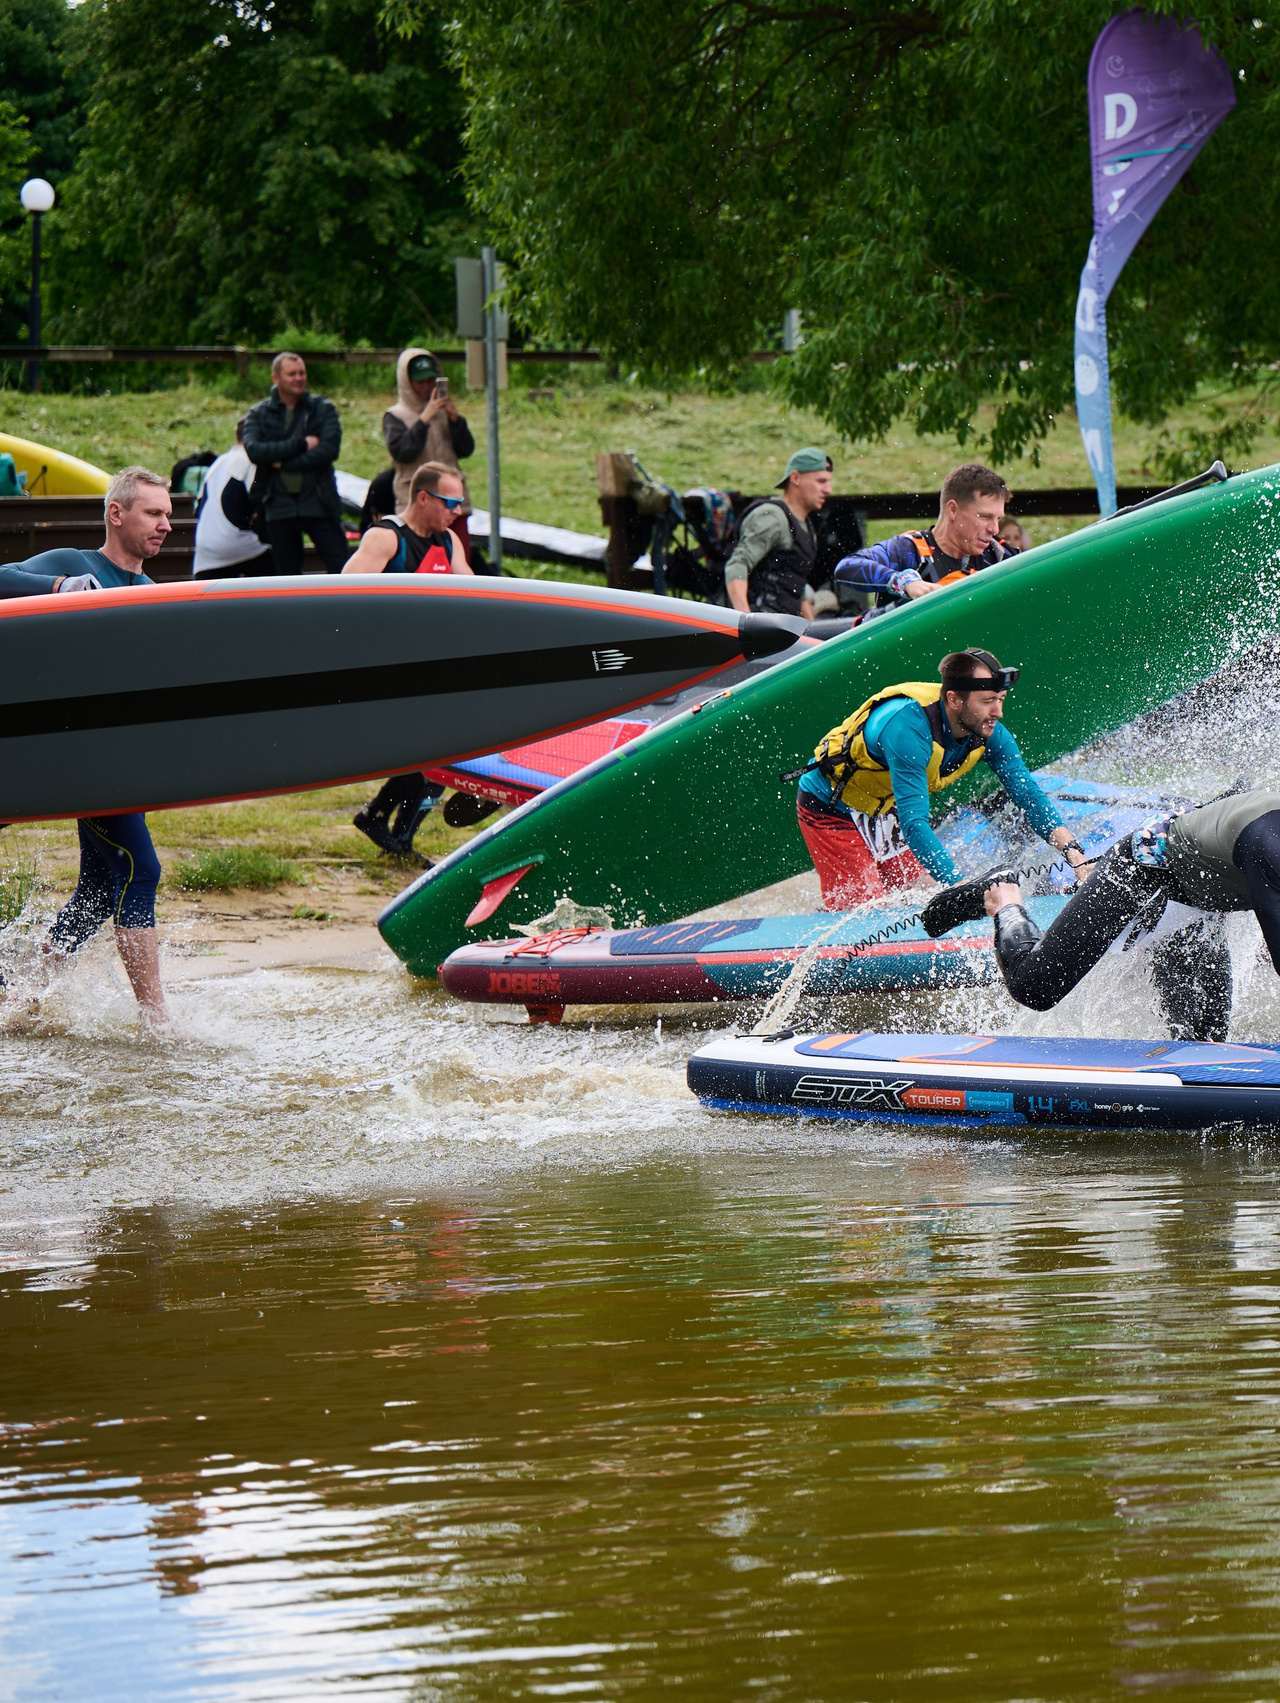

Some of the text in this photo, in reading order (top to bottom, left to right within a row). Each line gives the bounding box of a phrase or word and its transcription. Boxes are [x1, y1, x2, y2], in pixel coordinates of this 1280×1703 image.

[487, 972, 541, 995] JOBE
[791, 1074, 916, 1110] STX
[910, 1094, 961, 1106] TOURER
[1070, 1099, 1092, 1111] FXL
[1094, 1102, 1112, 1112] honey
[1122, 1102, 1134, 1113] grip
